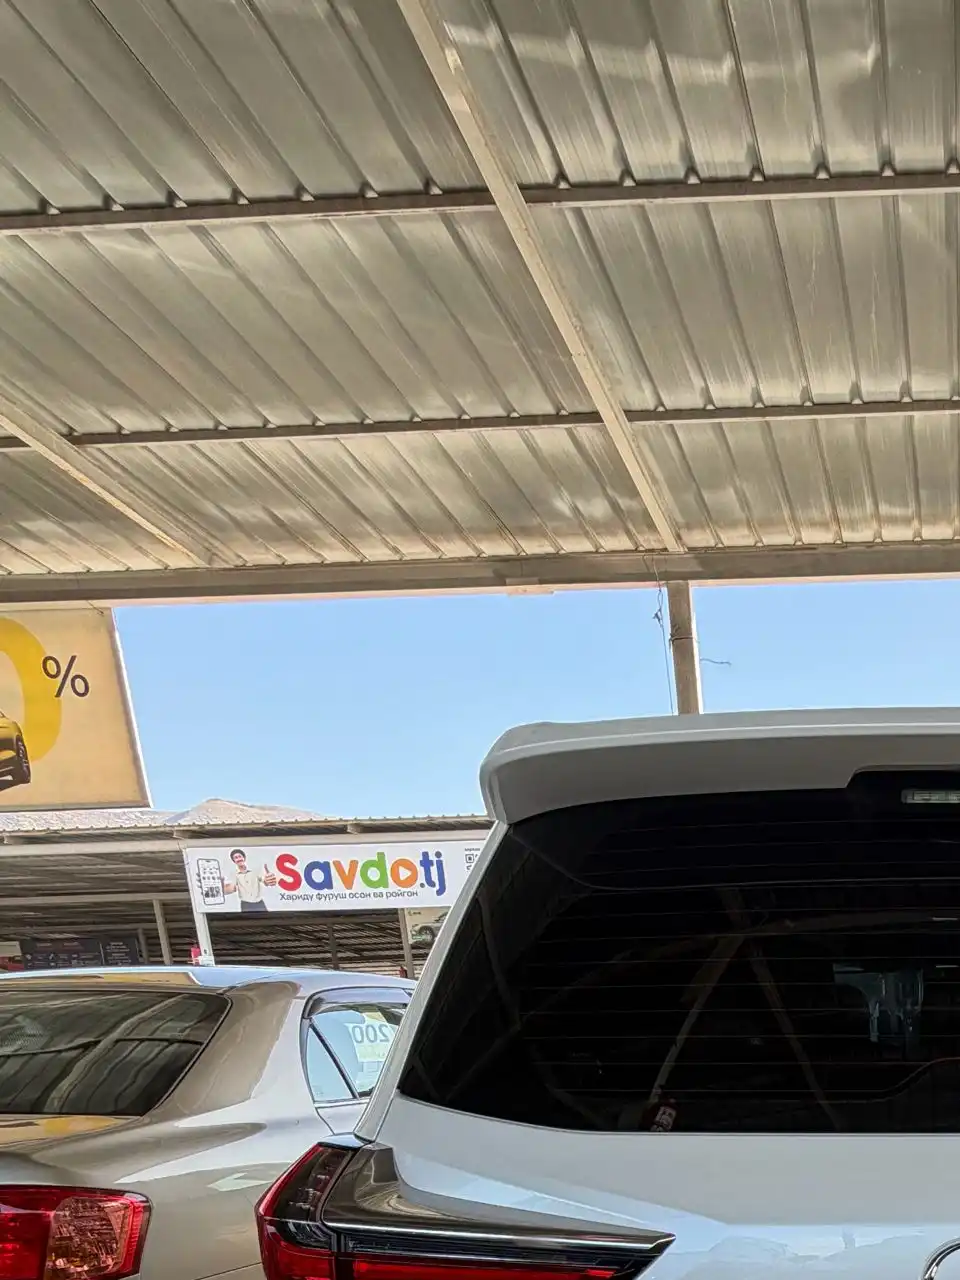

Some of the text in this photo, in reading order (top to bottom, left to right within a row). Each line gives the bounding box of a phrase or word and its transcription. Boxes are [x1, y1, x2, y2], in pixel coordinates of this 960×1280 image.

[275, 850, 447, 897] Savdo.tj
[279, 892, 313, 902] Хариду
[385, 889, 419, 900] ройгон
